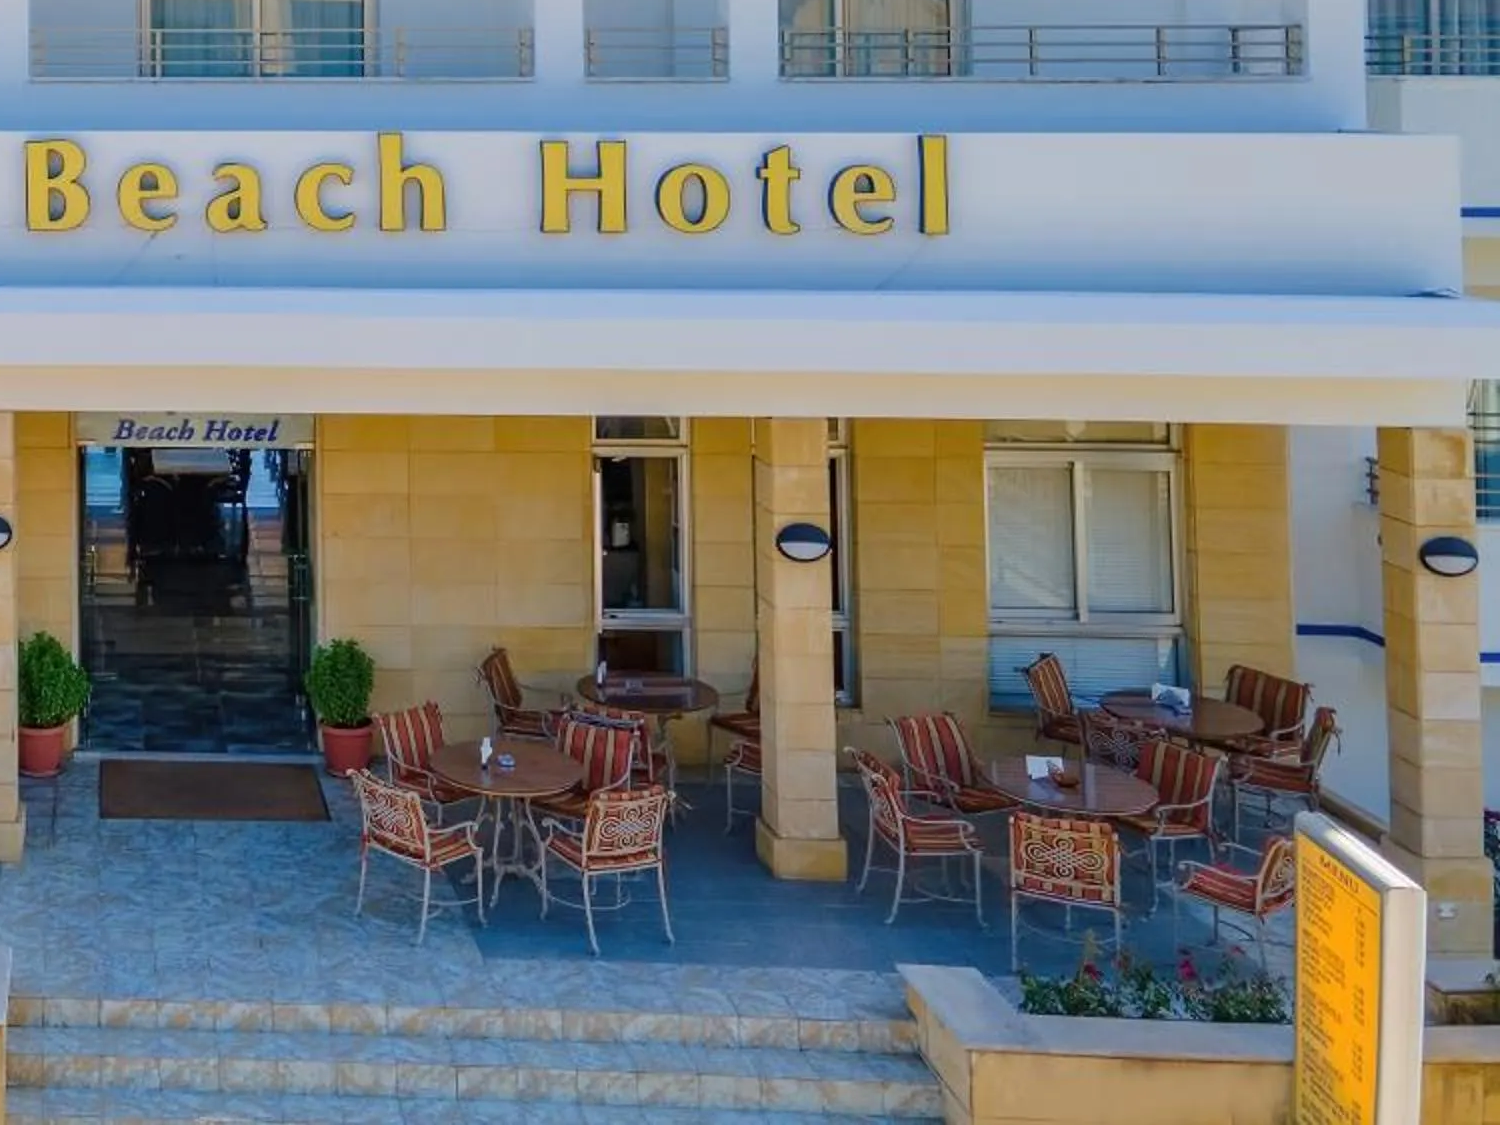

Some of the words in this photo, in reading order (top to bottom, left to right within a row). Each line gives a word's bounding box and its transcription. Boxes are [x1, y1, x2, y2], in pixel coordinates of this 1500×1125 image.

[24, 132, 446, 233] Beach
[539, 134, 949, 236] Hotel
[113, 418, 195, 441] Beach
[202, 418, 280, 443] Hotel
